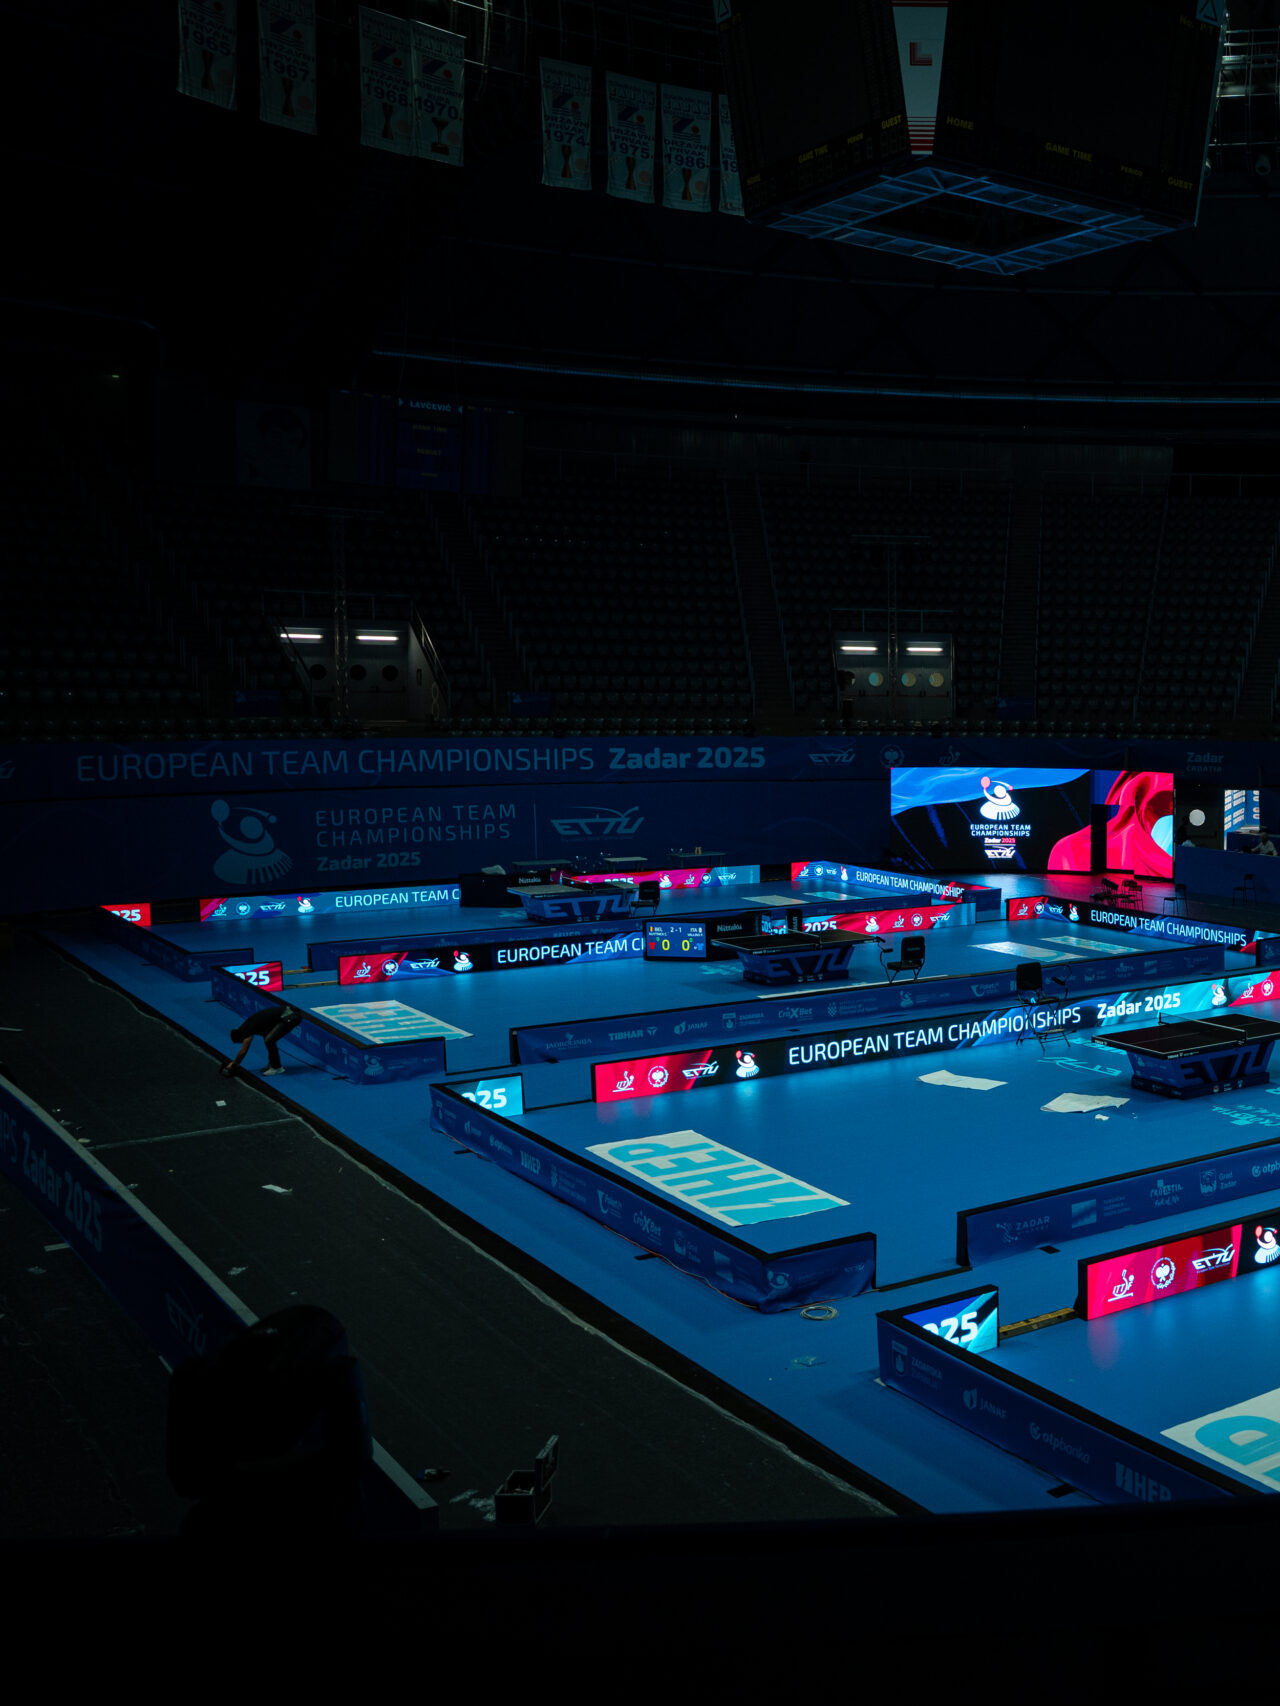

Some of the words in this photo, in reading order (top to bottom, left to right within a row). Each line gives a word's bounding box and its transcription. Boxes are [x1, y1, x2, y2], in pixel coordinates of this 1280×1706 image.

[946, 116, 974, 130] HOME
[1045, 142, 1071, 157] GAME
[1073, 149, 1093, 162] TIME
[1168, 177, 1194, 190] GUEST
[76, 751, 253, 782] EUROPEAN
[262, 748, 349, 776] TEAM
[358, 747, 594, 774] CHAMPIONSHIPS
[609, 746, 690, 770] Zadar
[698, 746, 765, 769] 2025
[1186, 752, 1225, 764] Zadar
[316, 806, 442, 828] EUROPEAN
[453, 803, 517, 822] TEAM
[317, 823, 511, 848] CHAMPIONSHIPS
[317, 854, 372, 872] Zadar
[377, 851, 422, 868] 2025
[856, 870, 889, 886] EUROPEAN
[890, 876, 908, 889] TEAM
[909, 879, 965, 898] CHAMPIONSHIPS
[335, 892, 409, 909] EUROPEAN
[412, 890, 443, 903] TEAM
[111, 909, 142, 922] 25
[717, 923, 743, 933] Nittaku
[1090, 909, 1138, 929] EUROPEAN
[1139, 917, 1165, 933] TEAM
[1167, 922, 1247, 947] CHAMPIONSHIPS
[497, 944, 581, 964] EUROPEAN
[586, 940, 628, 957] TEAM
[662, 939, 670, 951] 0
[682, 939, 690, 951] 0
[410, 957, 440, 970] ETTU
[234, 970, 270, 987] 25
[608, 1029, 644, 1041] TIBHAR
[789, 1034, 889, 1066] EUROPEAN
[894, 1026, 945, 1051] TEAM
[947, 1007, 1081, 1045] CHAMPIONSHIPS
[1097, 1000, 1142, 1019] Zadar
[1145, 992, 1181, 1011] 2025
[682, 1061, 720, 1079] ETTU
[1180, 1041, 1272, 1084] ETTU
[462, 1087, 508, 1111] 25
[527, 1155, 541, 1176] HEP
[22, 1130, 63, 1208] Zadar
[64, 1171, 103, 1254] 2025
[1016, 1216, 1050, 1231] ZADAR
[1192, 1243, 1235, 1272] ETTU
[922, 1310, 979, 1345] 25
[979, 1398, 1007, 1420] JANAF
[1042, 1430, 1091, 1465] otpbanka
